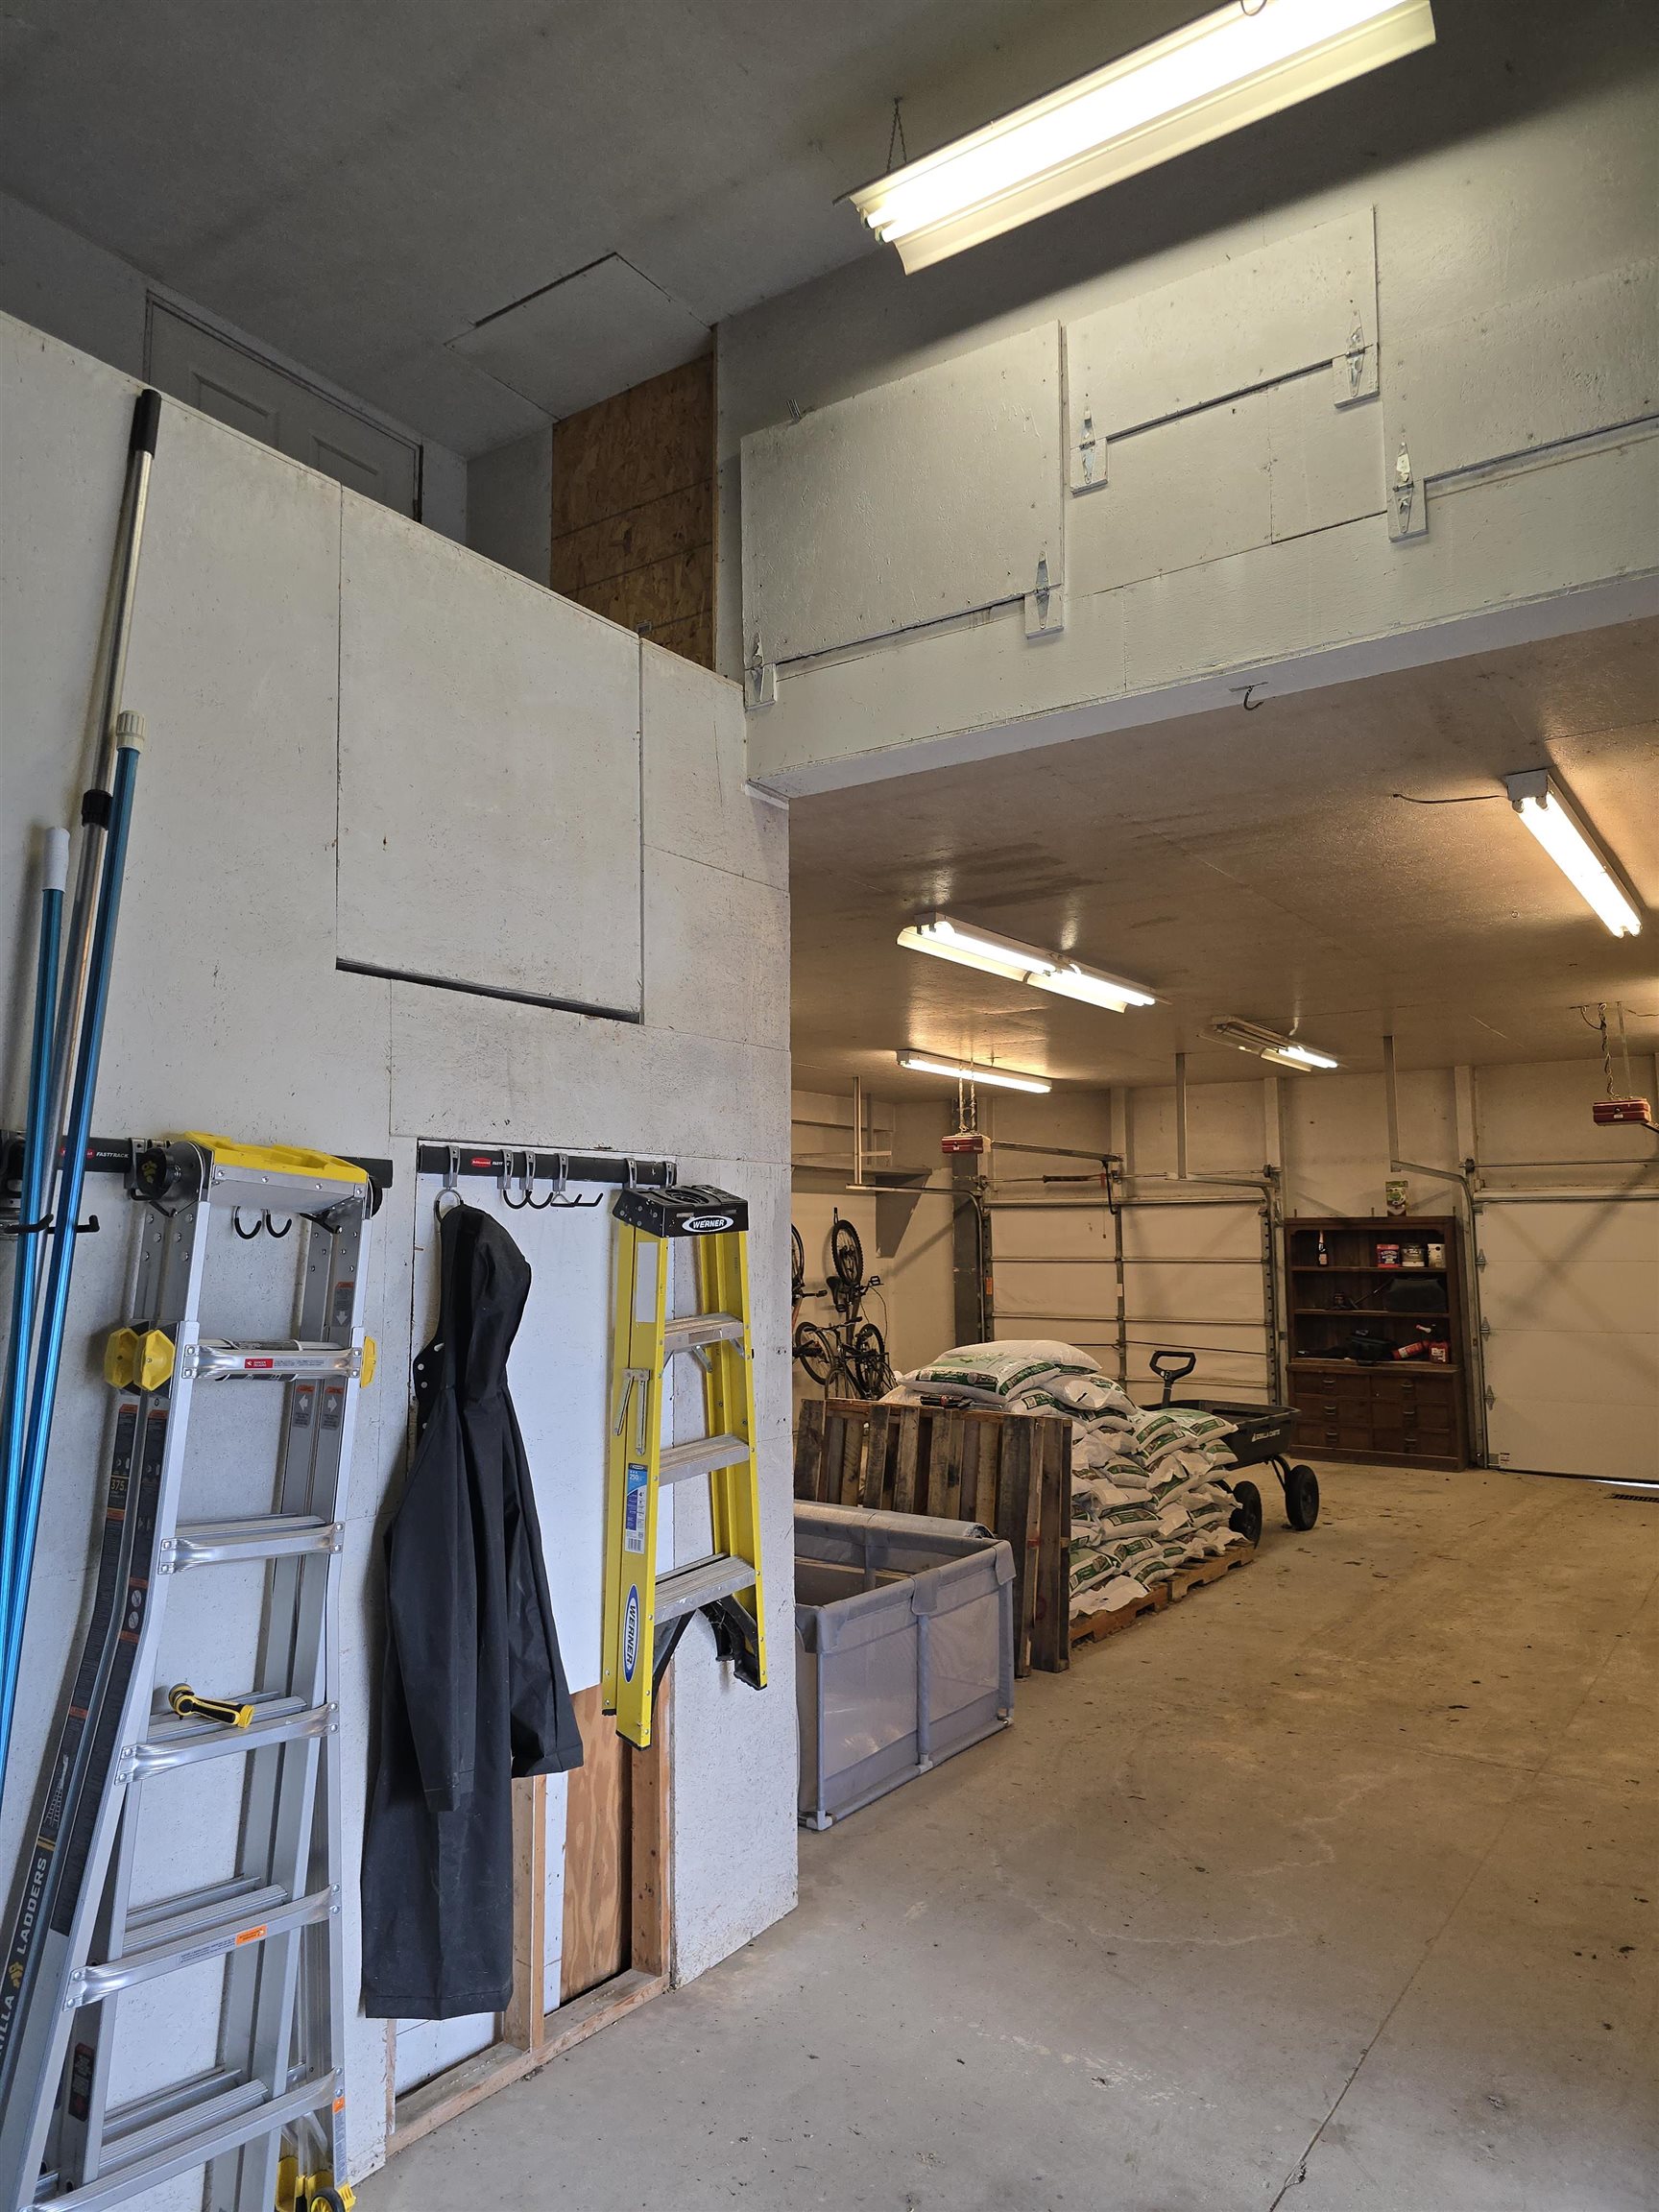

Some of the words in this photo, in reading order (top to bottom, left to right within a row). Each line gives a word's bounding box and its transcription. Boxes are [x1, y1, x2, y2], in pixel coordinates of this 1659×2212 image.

[692, 1219, 725, 1229] WERNER
[110, 1479, 125, 1491] 375
[626, 1603, 637, 1665] WERNER
[16, 1857, 47, 1955] LADDERS
